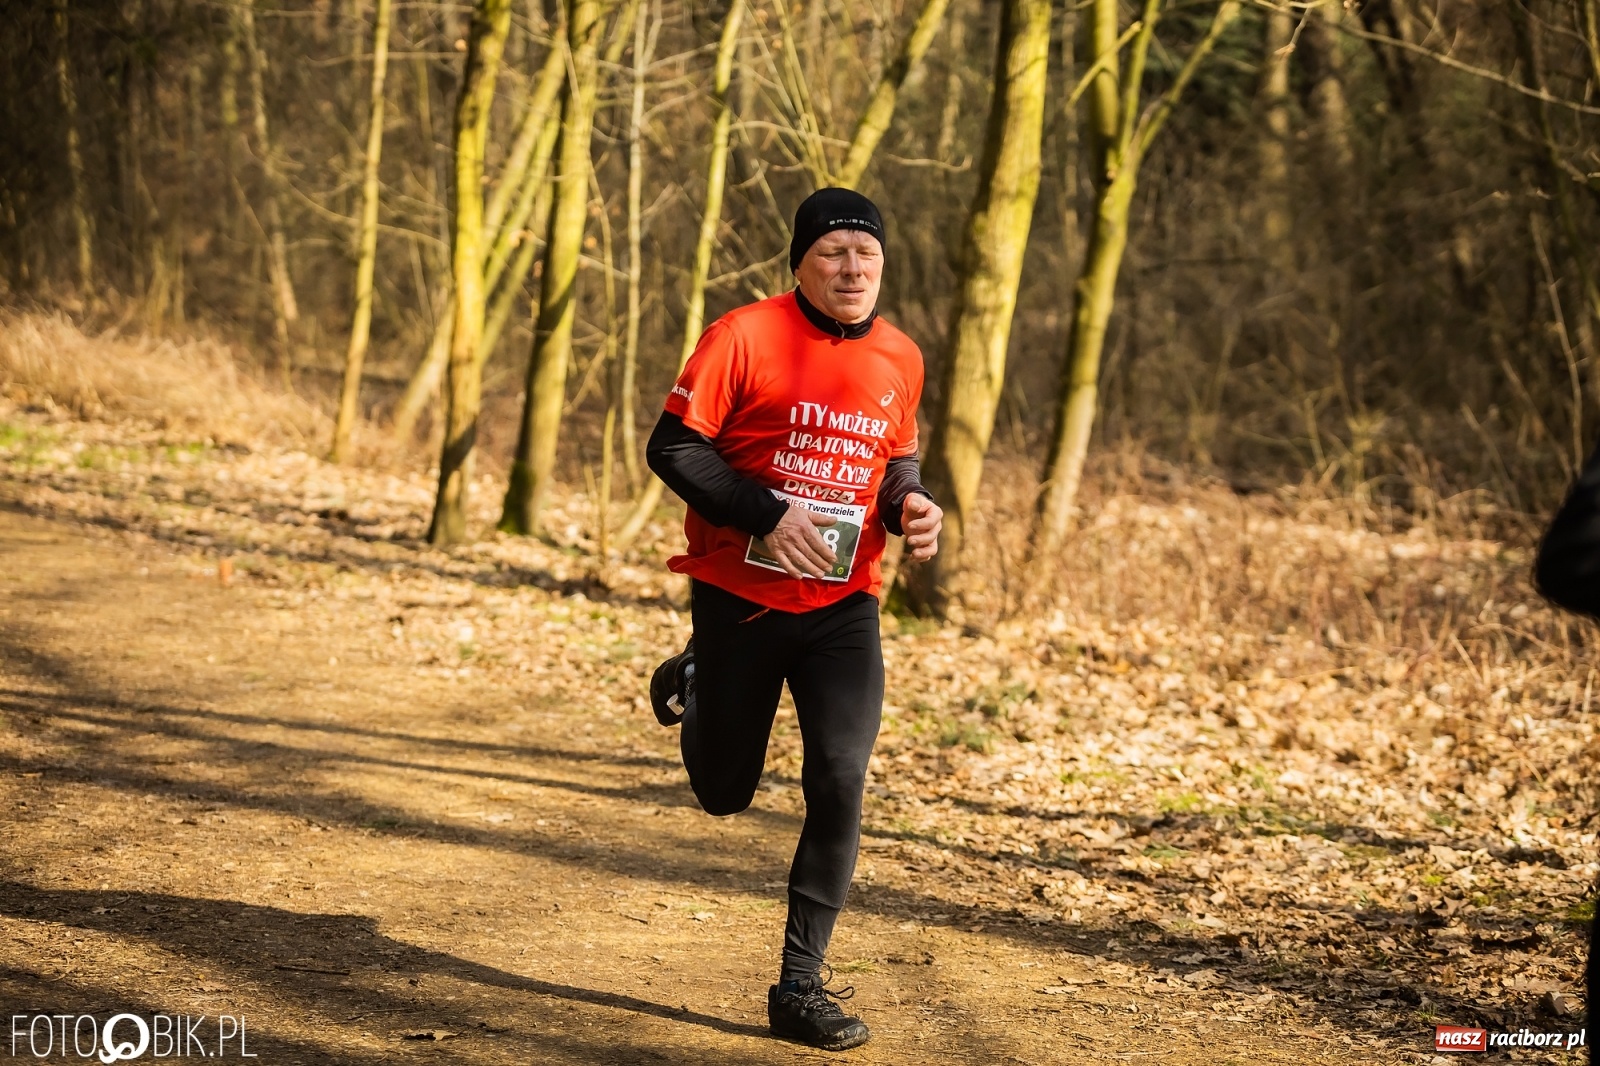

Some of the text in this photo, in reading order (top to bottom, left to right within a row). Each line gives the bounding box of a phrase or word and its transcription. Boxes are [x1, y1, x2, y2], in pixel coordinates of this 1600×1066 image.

[798, 401, 828, 427] TY
[828, 410, 889, 439] MOŻESZ
[788, 431, 879, 460] URATOWAĆ
[773, 450, 874, 484] KOMUŚ ŻYCIE
[783, 478, 842, 501] DKMS
[808, 502, 855, 517] Twardziela
